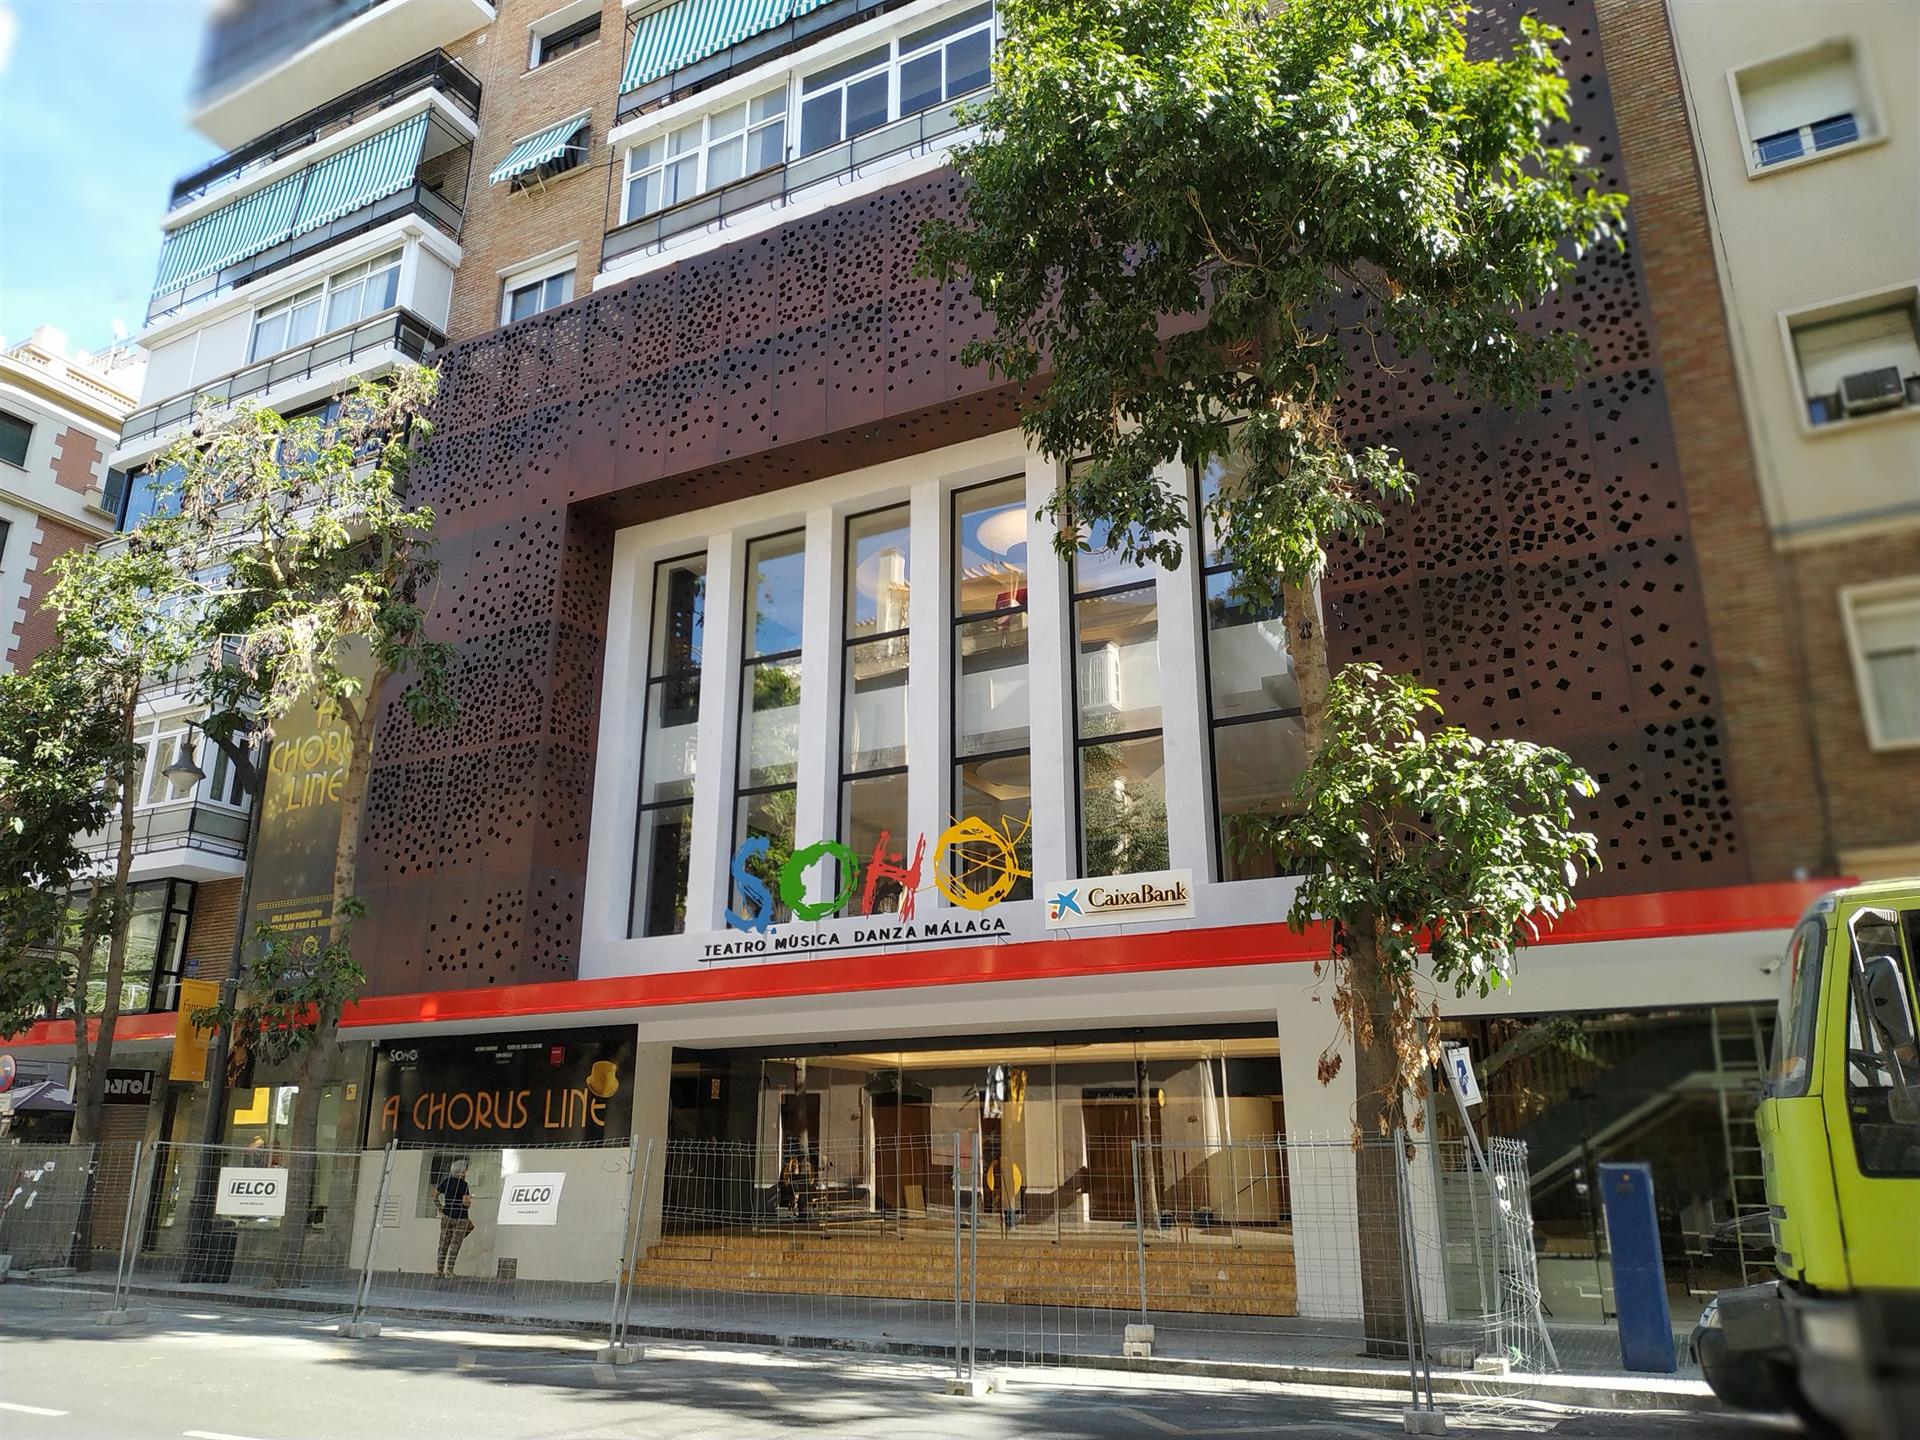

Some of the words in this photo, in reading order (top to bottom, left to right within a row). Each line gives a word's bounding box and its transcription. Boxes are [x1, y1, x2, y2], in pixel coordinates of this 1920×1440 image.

[318, 697, 336, 729] A
[269, 728, 353, 775] CHORU
[288, 768, 344, 811] LINE
[725, 809, 1034, 935] SOHO
[1088, 881, 1188, 908] CaixaBank
[703, 938, 767, 957] TEATRO
[774, 932, 841, 950] MÚSICA
[853, 925, 917, 943] DANZA
[924, 917, 1007, 936] MÁLAGA
[389, 1049, 419, 1063] SOHO
[382, 1094, 401, 1132] A
[412, 1089, 531, 1132] CHORUS
[544, 1087, 607, 1130] LINE
[230, 1182, 276, 1195] IELCO
[511, 1187, 551, 1202] IELCO
